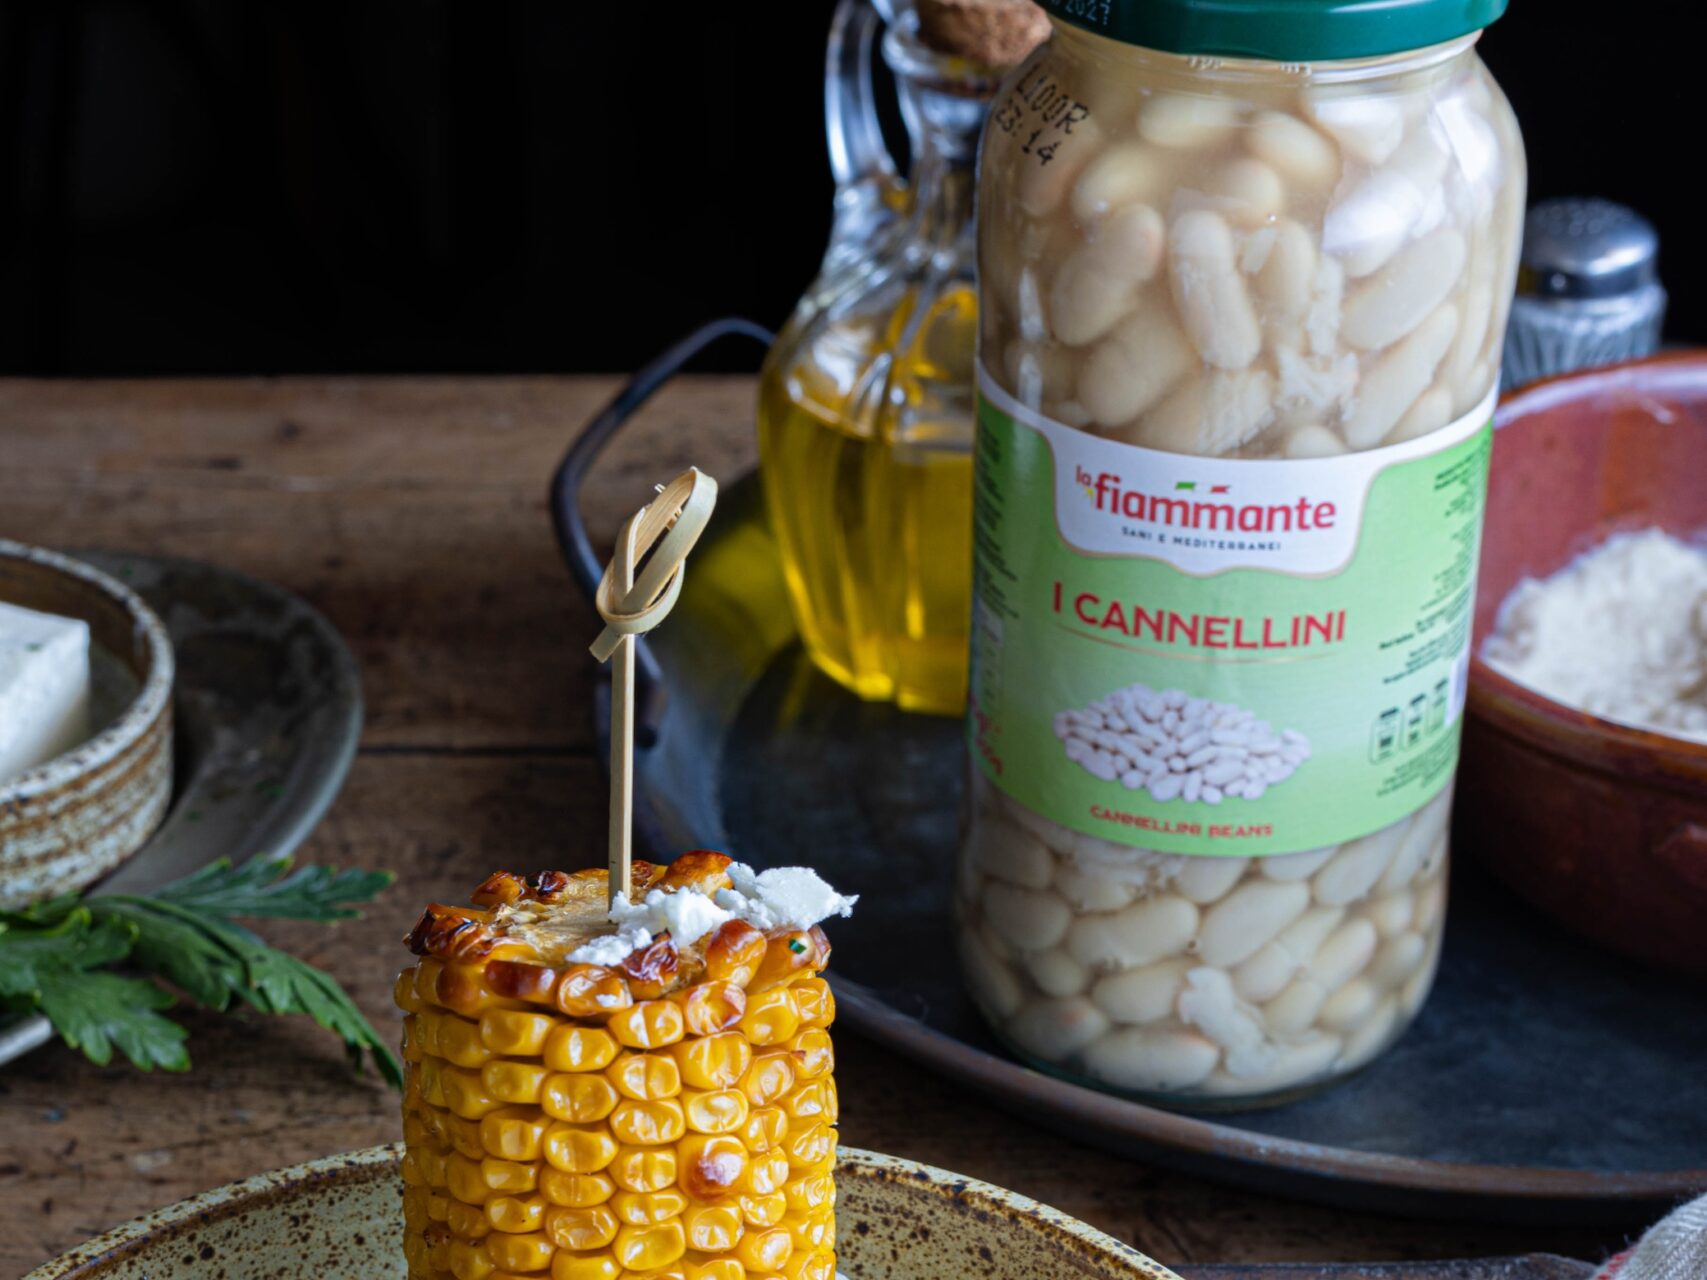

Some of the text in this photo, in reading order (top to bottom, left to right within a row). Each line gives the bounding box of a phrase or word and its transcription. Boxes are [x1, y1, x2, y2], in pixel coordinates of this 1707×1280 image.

[1075, 464, 1336, 533] la fiammante
[1121, 525, 1282, 551] SANI E MEDITERRANEI
[1053, 580, 1062, 614] I
[1074, 592, 1347, 650] CANNELLINI
[1089, 804, 1273, 838] CANNELLINI BEANS
